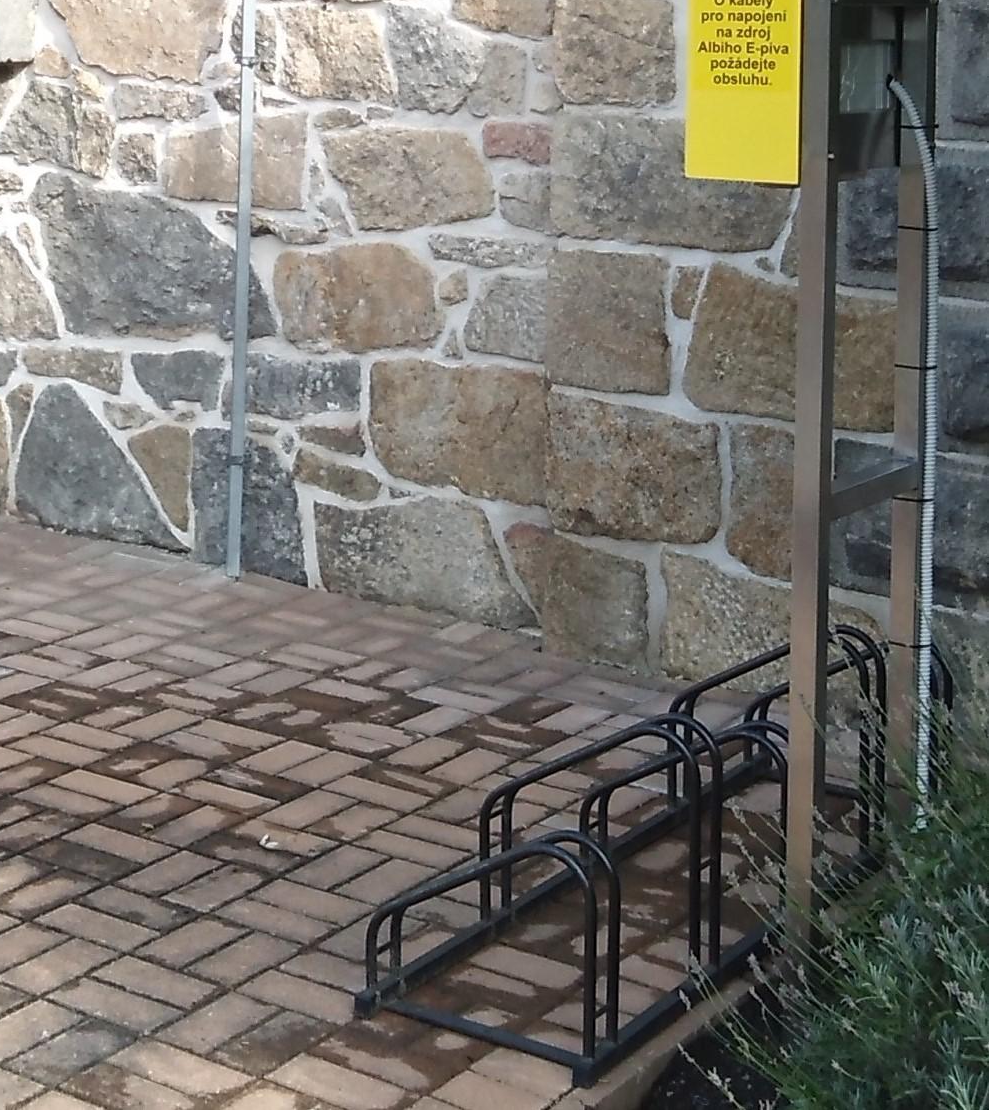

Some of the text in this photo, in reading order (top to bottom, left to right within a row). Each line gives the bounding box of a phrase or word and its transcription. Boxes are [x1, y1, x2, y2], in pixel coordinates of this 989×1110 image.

[701, 12, 724, 24] pro
[716, 25, 771, 41] na zdroj
[698, 41, 789, 57] Albiho E-piva
[710, 57, 776, 72] požádejte
[713, 72, 773, 86] obsluhu.
